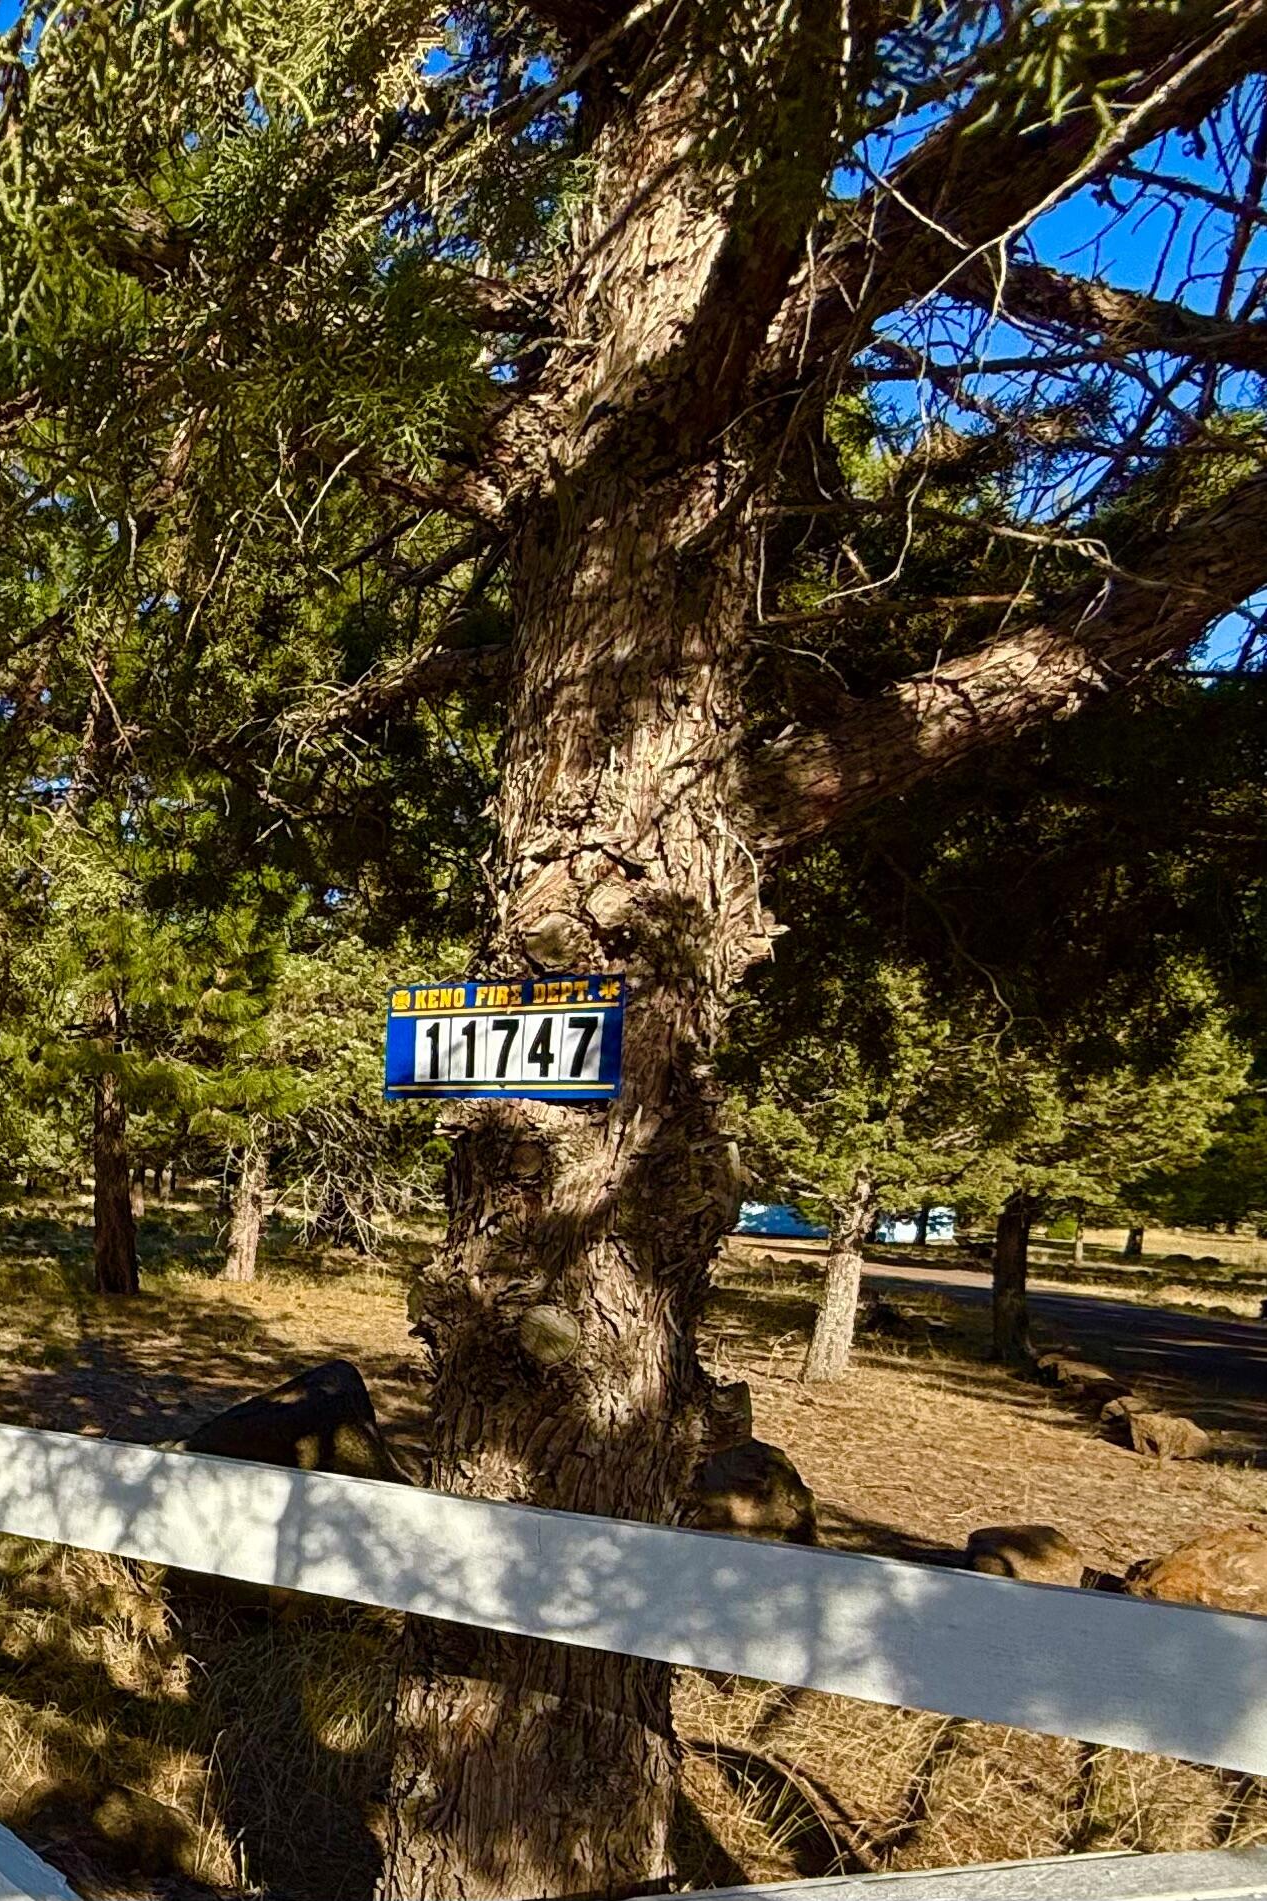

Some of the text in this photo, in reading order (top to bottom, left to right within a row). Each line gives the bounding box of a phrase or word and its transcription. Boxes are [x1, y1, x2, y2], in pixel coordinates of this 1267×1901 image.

[414, 987, 466, 1010] KENO
[475, 985, 523, 1008] FIRE
[425, 1015, 599, 1080] 11747
